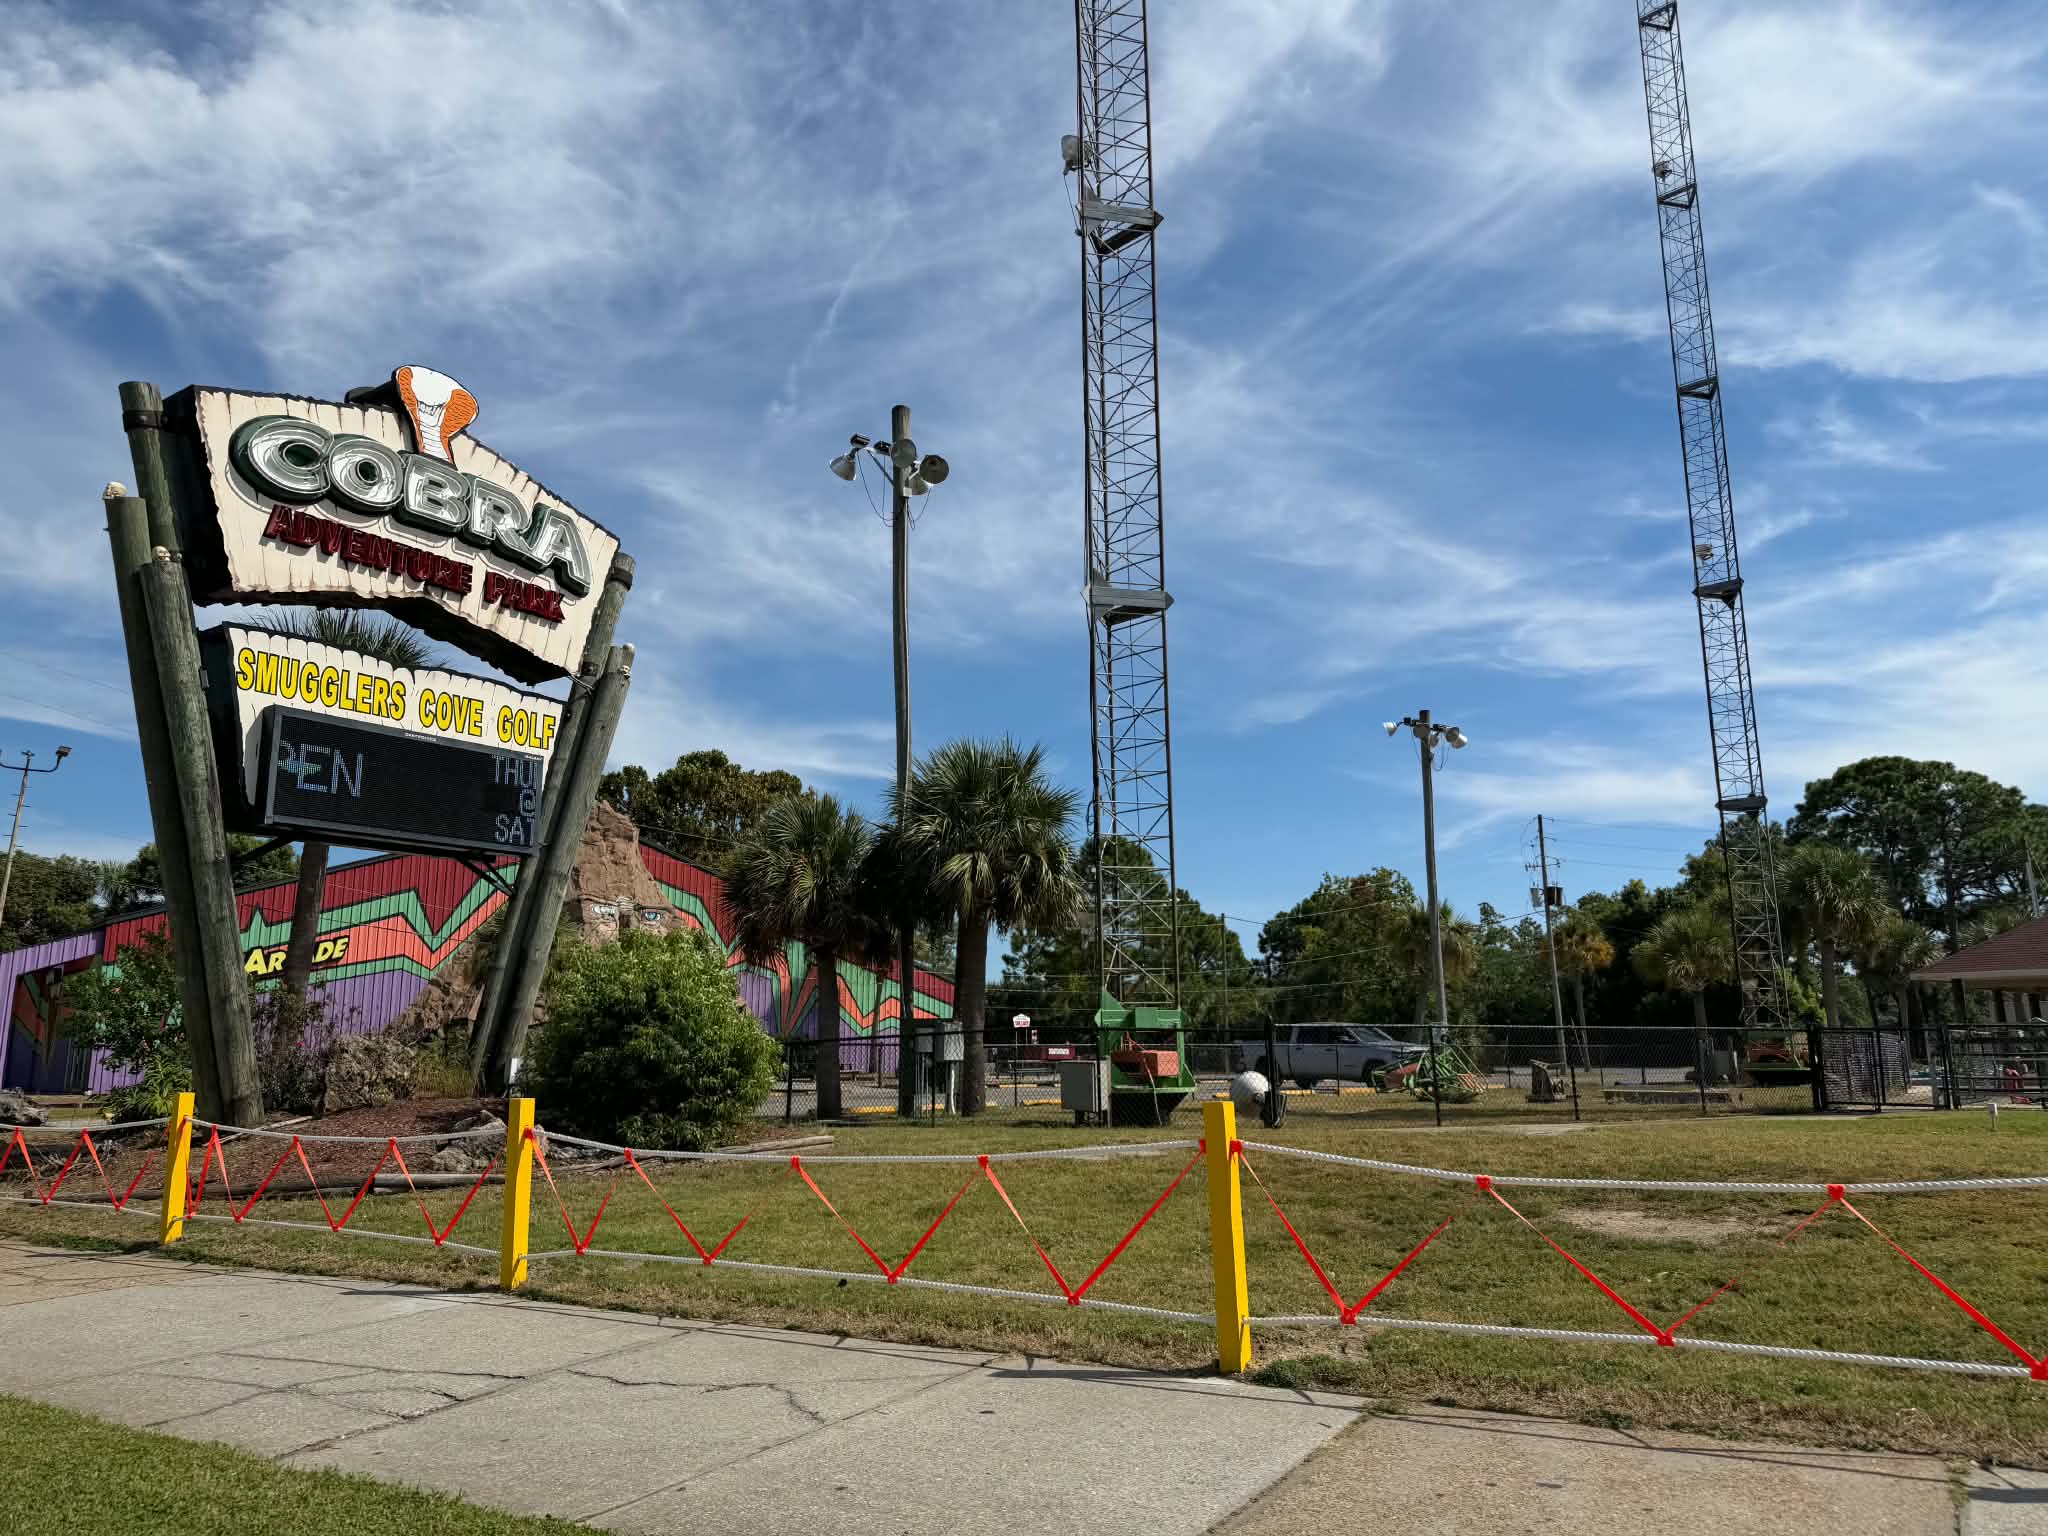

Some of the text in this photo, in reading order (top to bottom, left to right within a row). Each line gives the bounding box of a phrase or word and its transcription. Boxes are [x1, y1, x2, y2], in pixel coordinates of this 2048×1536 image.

[228, 415, 592, 598] COBRA
[262, 504, 565, 623] ADVENTURE PARK
[236, 647, 556, 750] SMUGGLERS COVE GOLF
[491, 753, 537, 790] THU
[244, 937, 349, 975] ARDE
